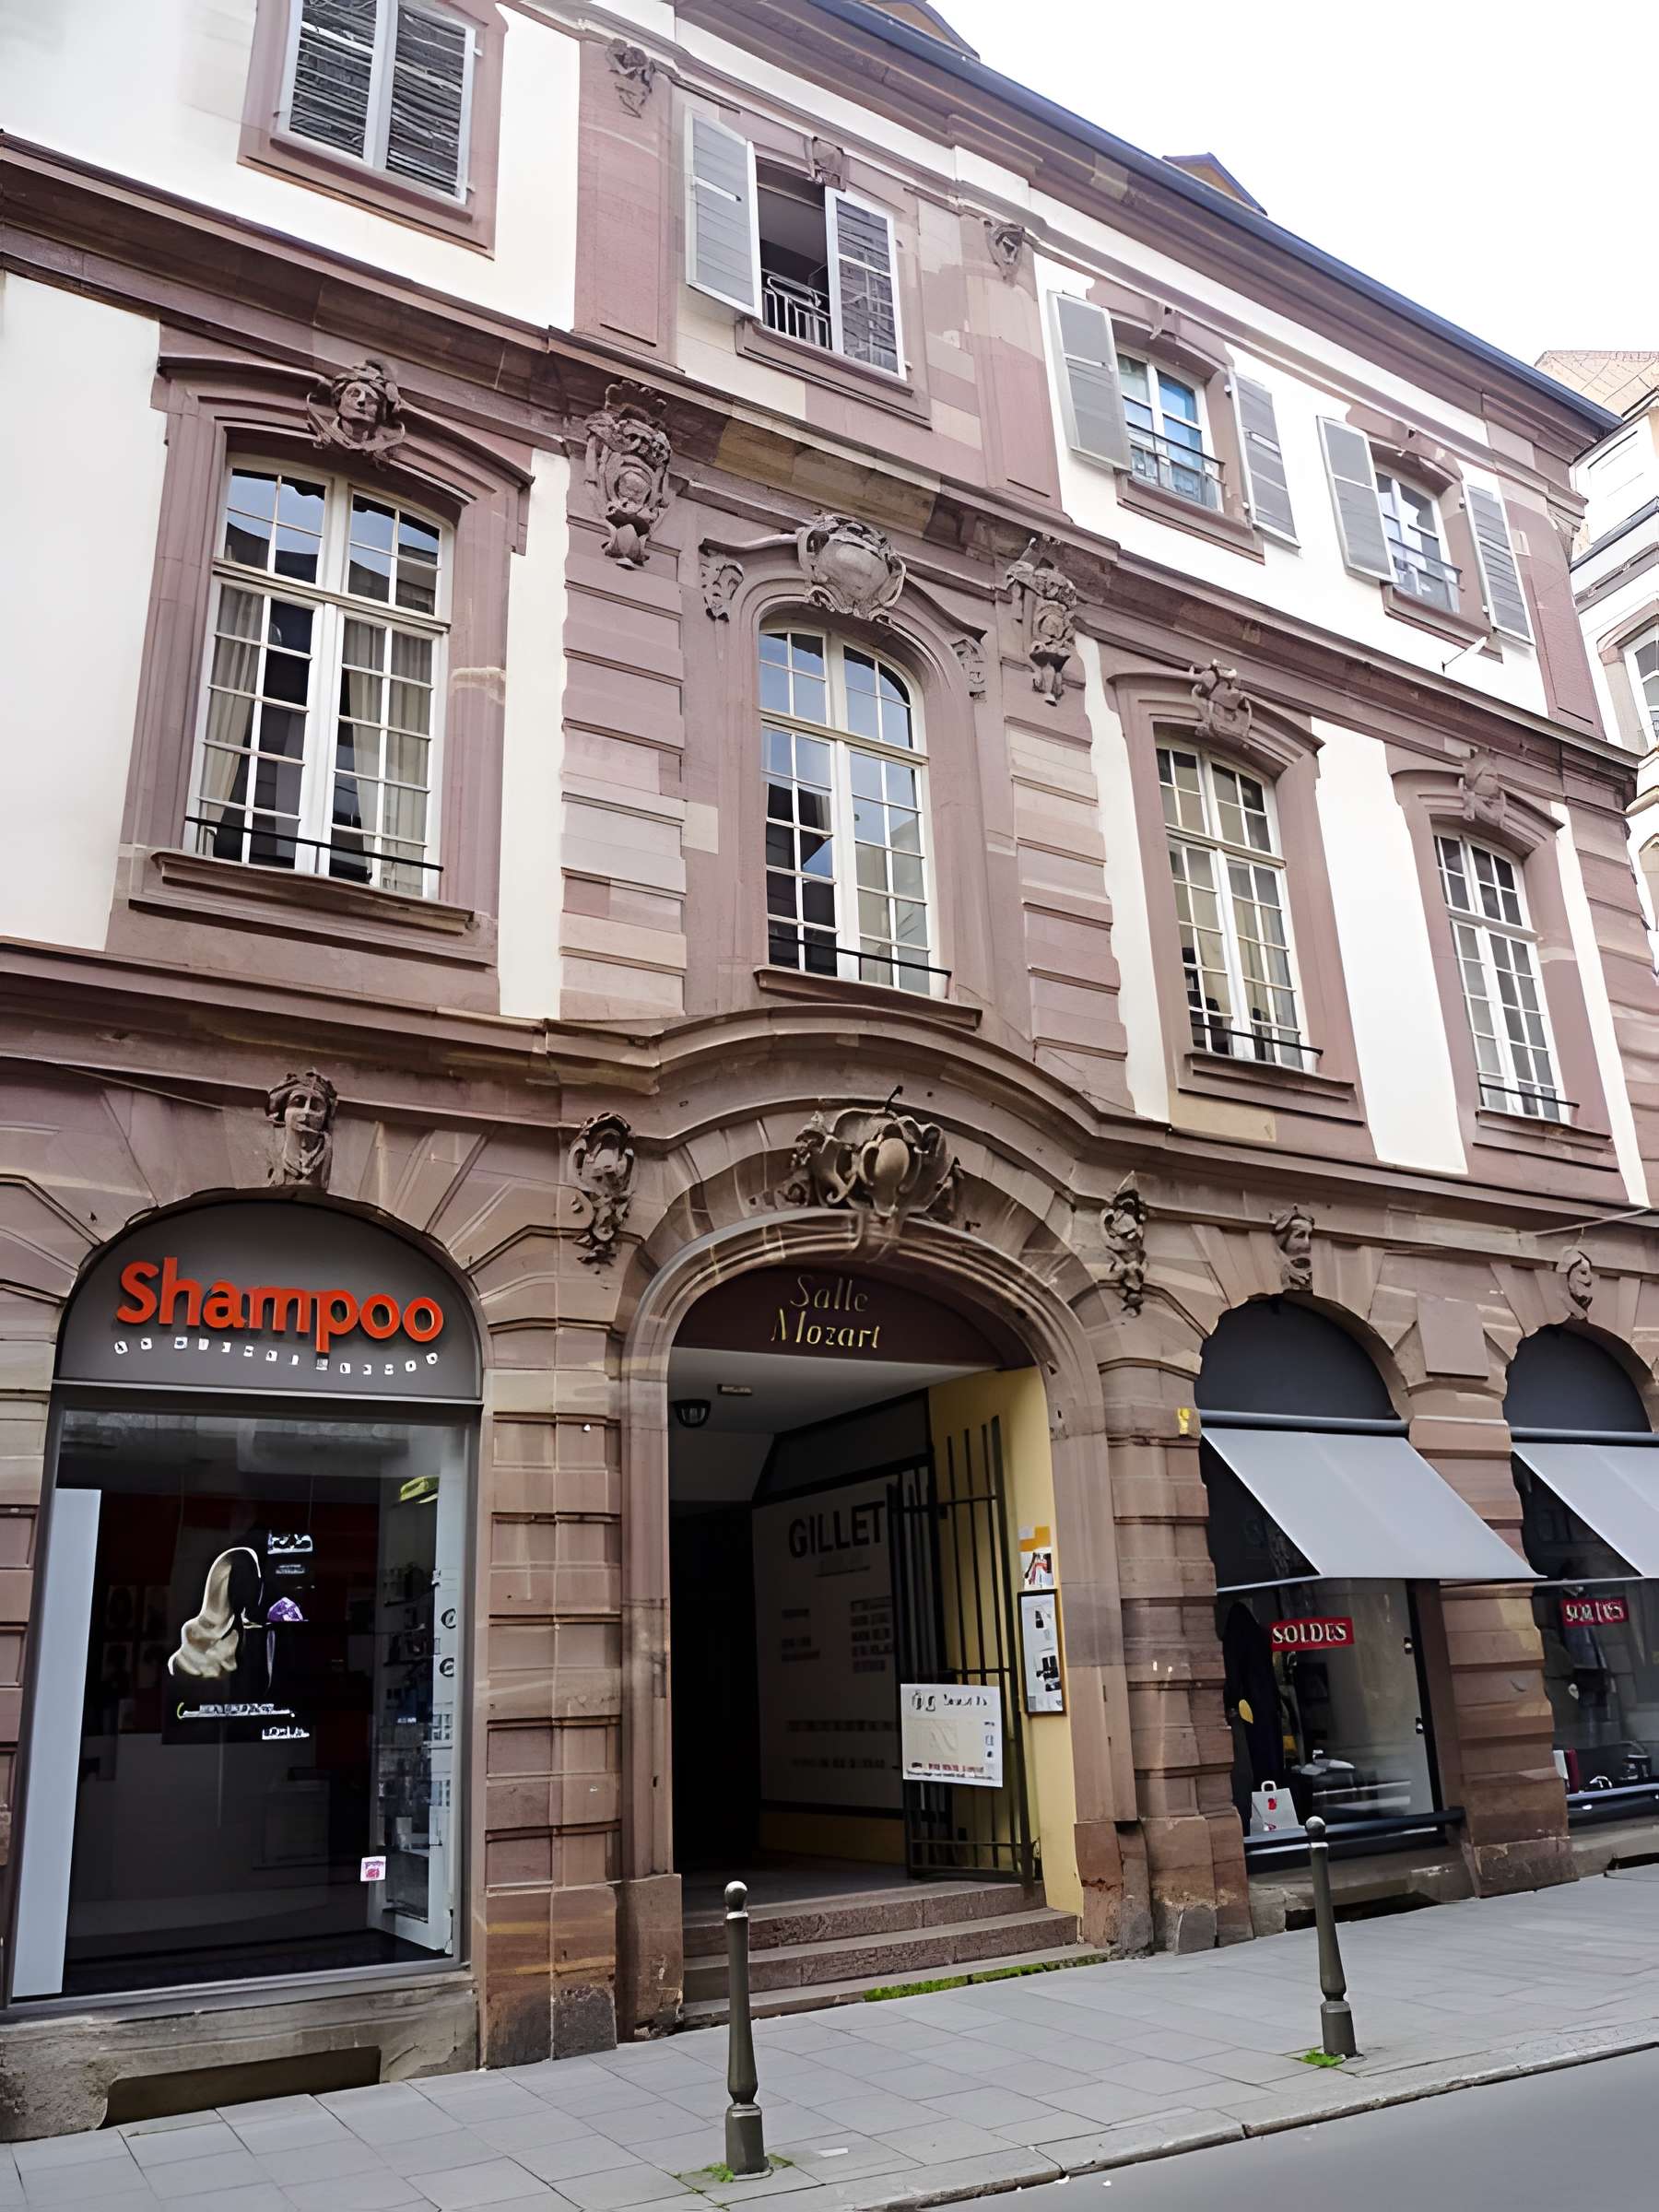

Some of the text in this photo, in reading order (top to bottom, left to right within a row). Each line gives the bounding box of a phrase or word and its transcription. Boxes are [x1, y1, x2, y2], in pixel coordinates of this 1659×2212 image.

[116, 1257, 444, 1353] Shampoo
[790, 1276, 868, 1312] Salle
[771, 1309, 880, 1348] Mozart
[1272, 1622, 1347, 1644] SOLDES
